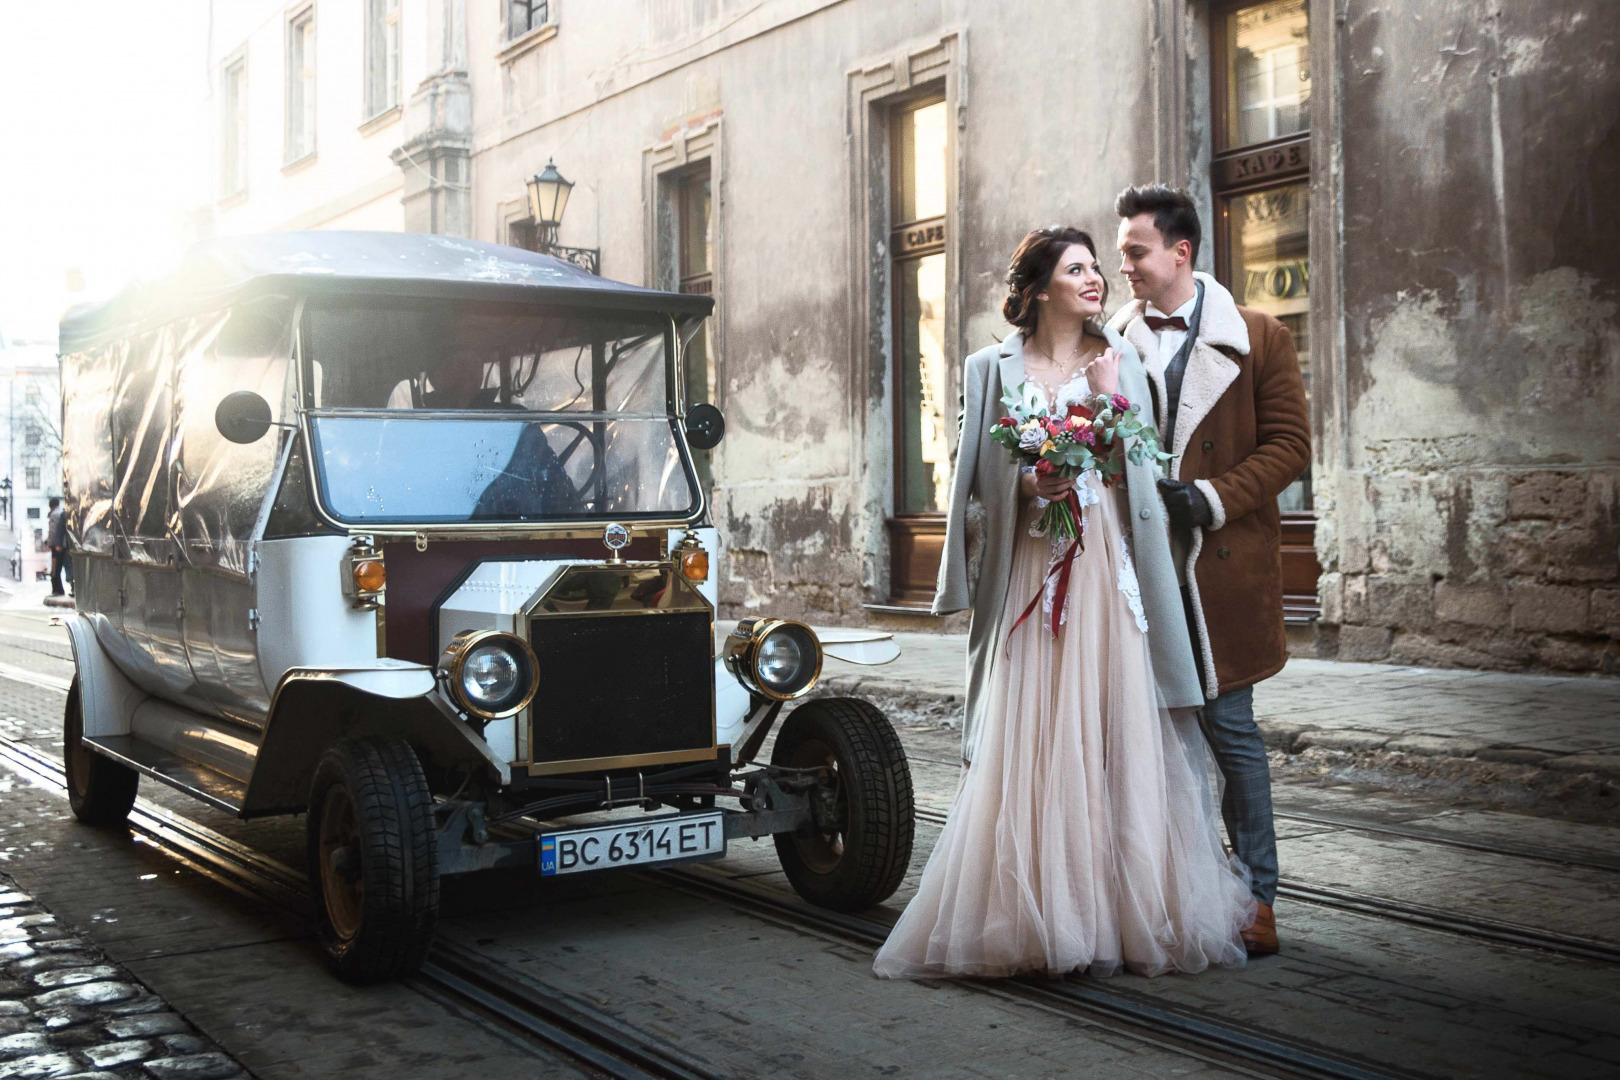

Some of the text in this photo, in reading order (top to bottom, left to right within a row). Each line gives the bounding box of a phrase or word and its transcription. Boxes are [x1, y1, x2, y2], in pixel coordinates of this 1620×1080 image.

[558, 820, 717, 870] BC 6314 ET
[541, 861, 555, 871] UA
